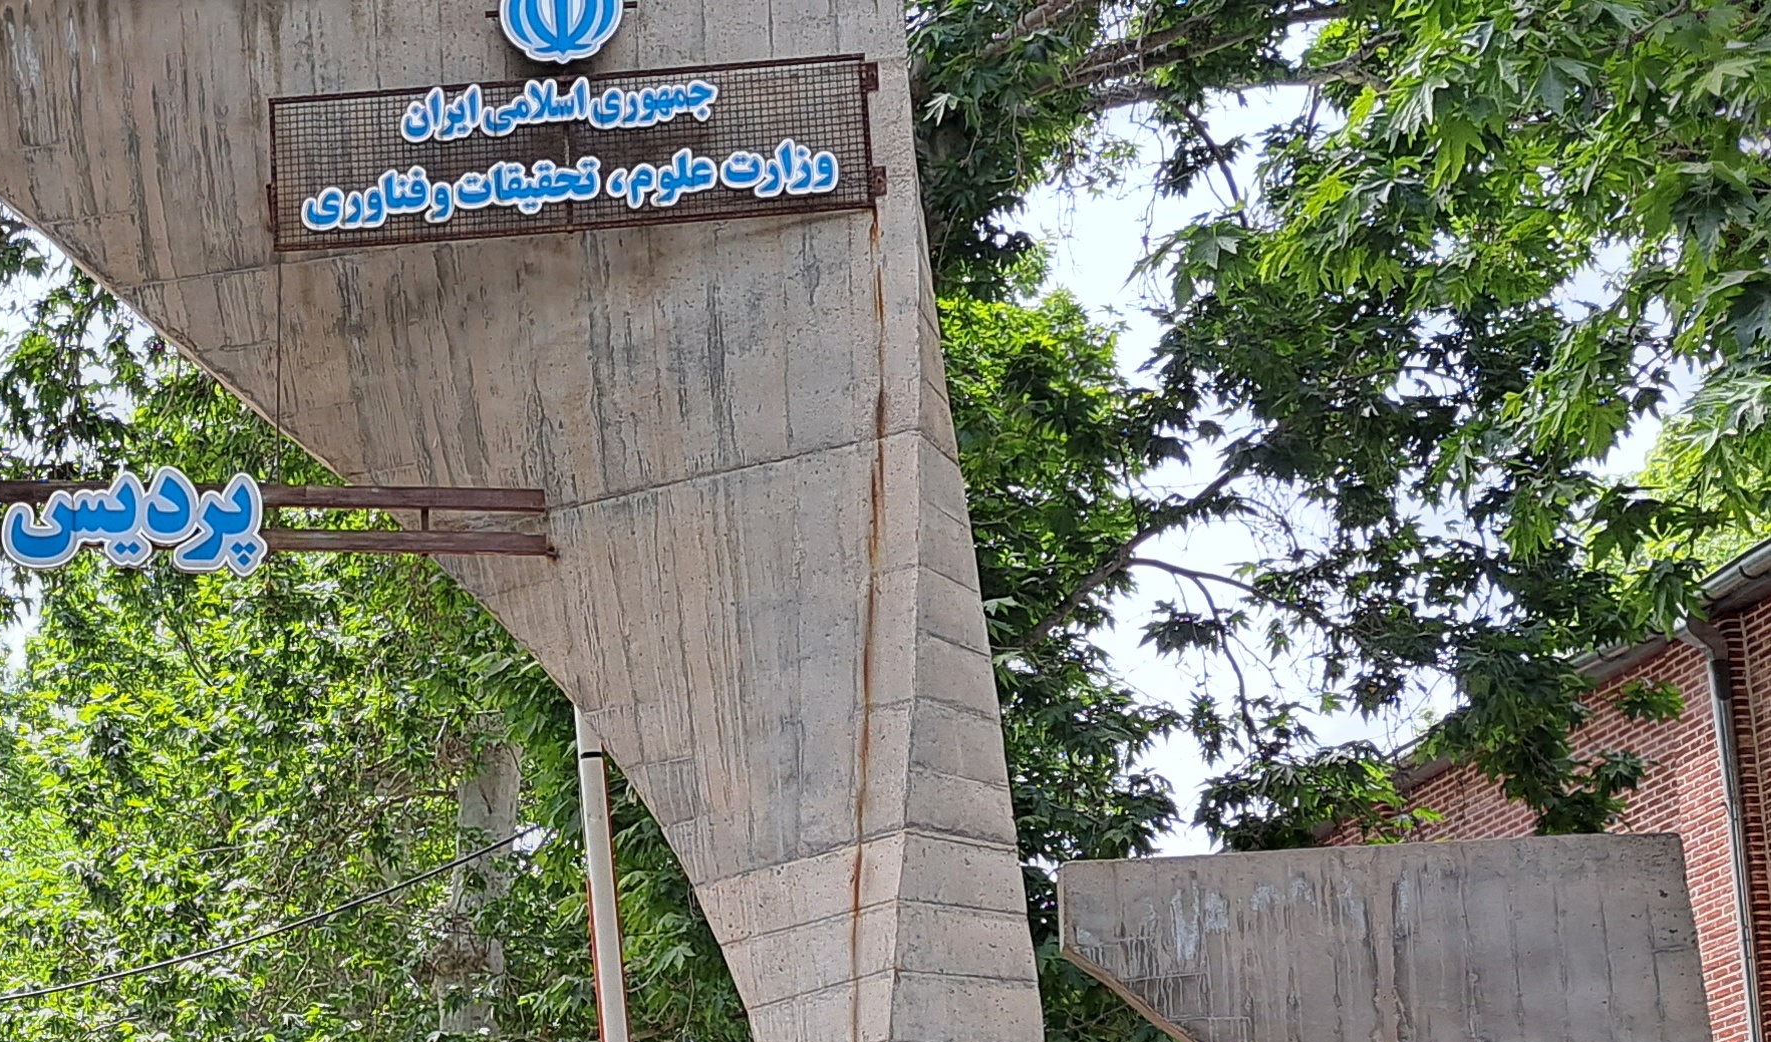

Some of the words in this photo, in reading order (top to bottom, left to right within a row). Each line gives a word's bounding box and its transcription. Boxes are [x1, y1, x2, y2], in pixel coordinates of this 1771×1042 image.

[401, 84, 480, 142] ایران
[482, 76, 588, 136] اسلامی
[589, 78, 718, 129] جمهوری
[455, 156, 600, 213] تحقیقات
[727, 139, 838, 197] وزارت
[301, 166, 430, 231] فناوری
[1, 464, 265, 577] پردیس
